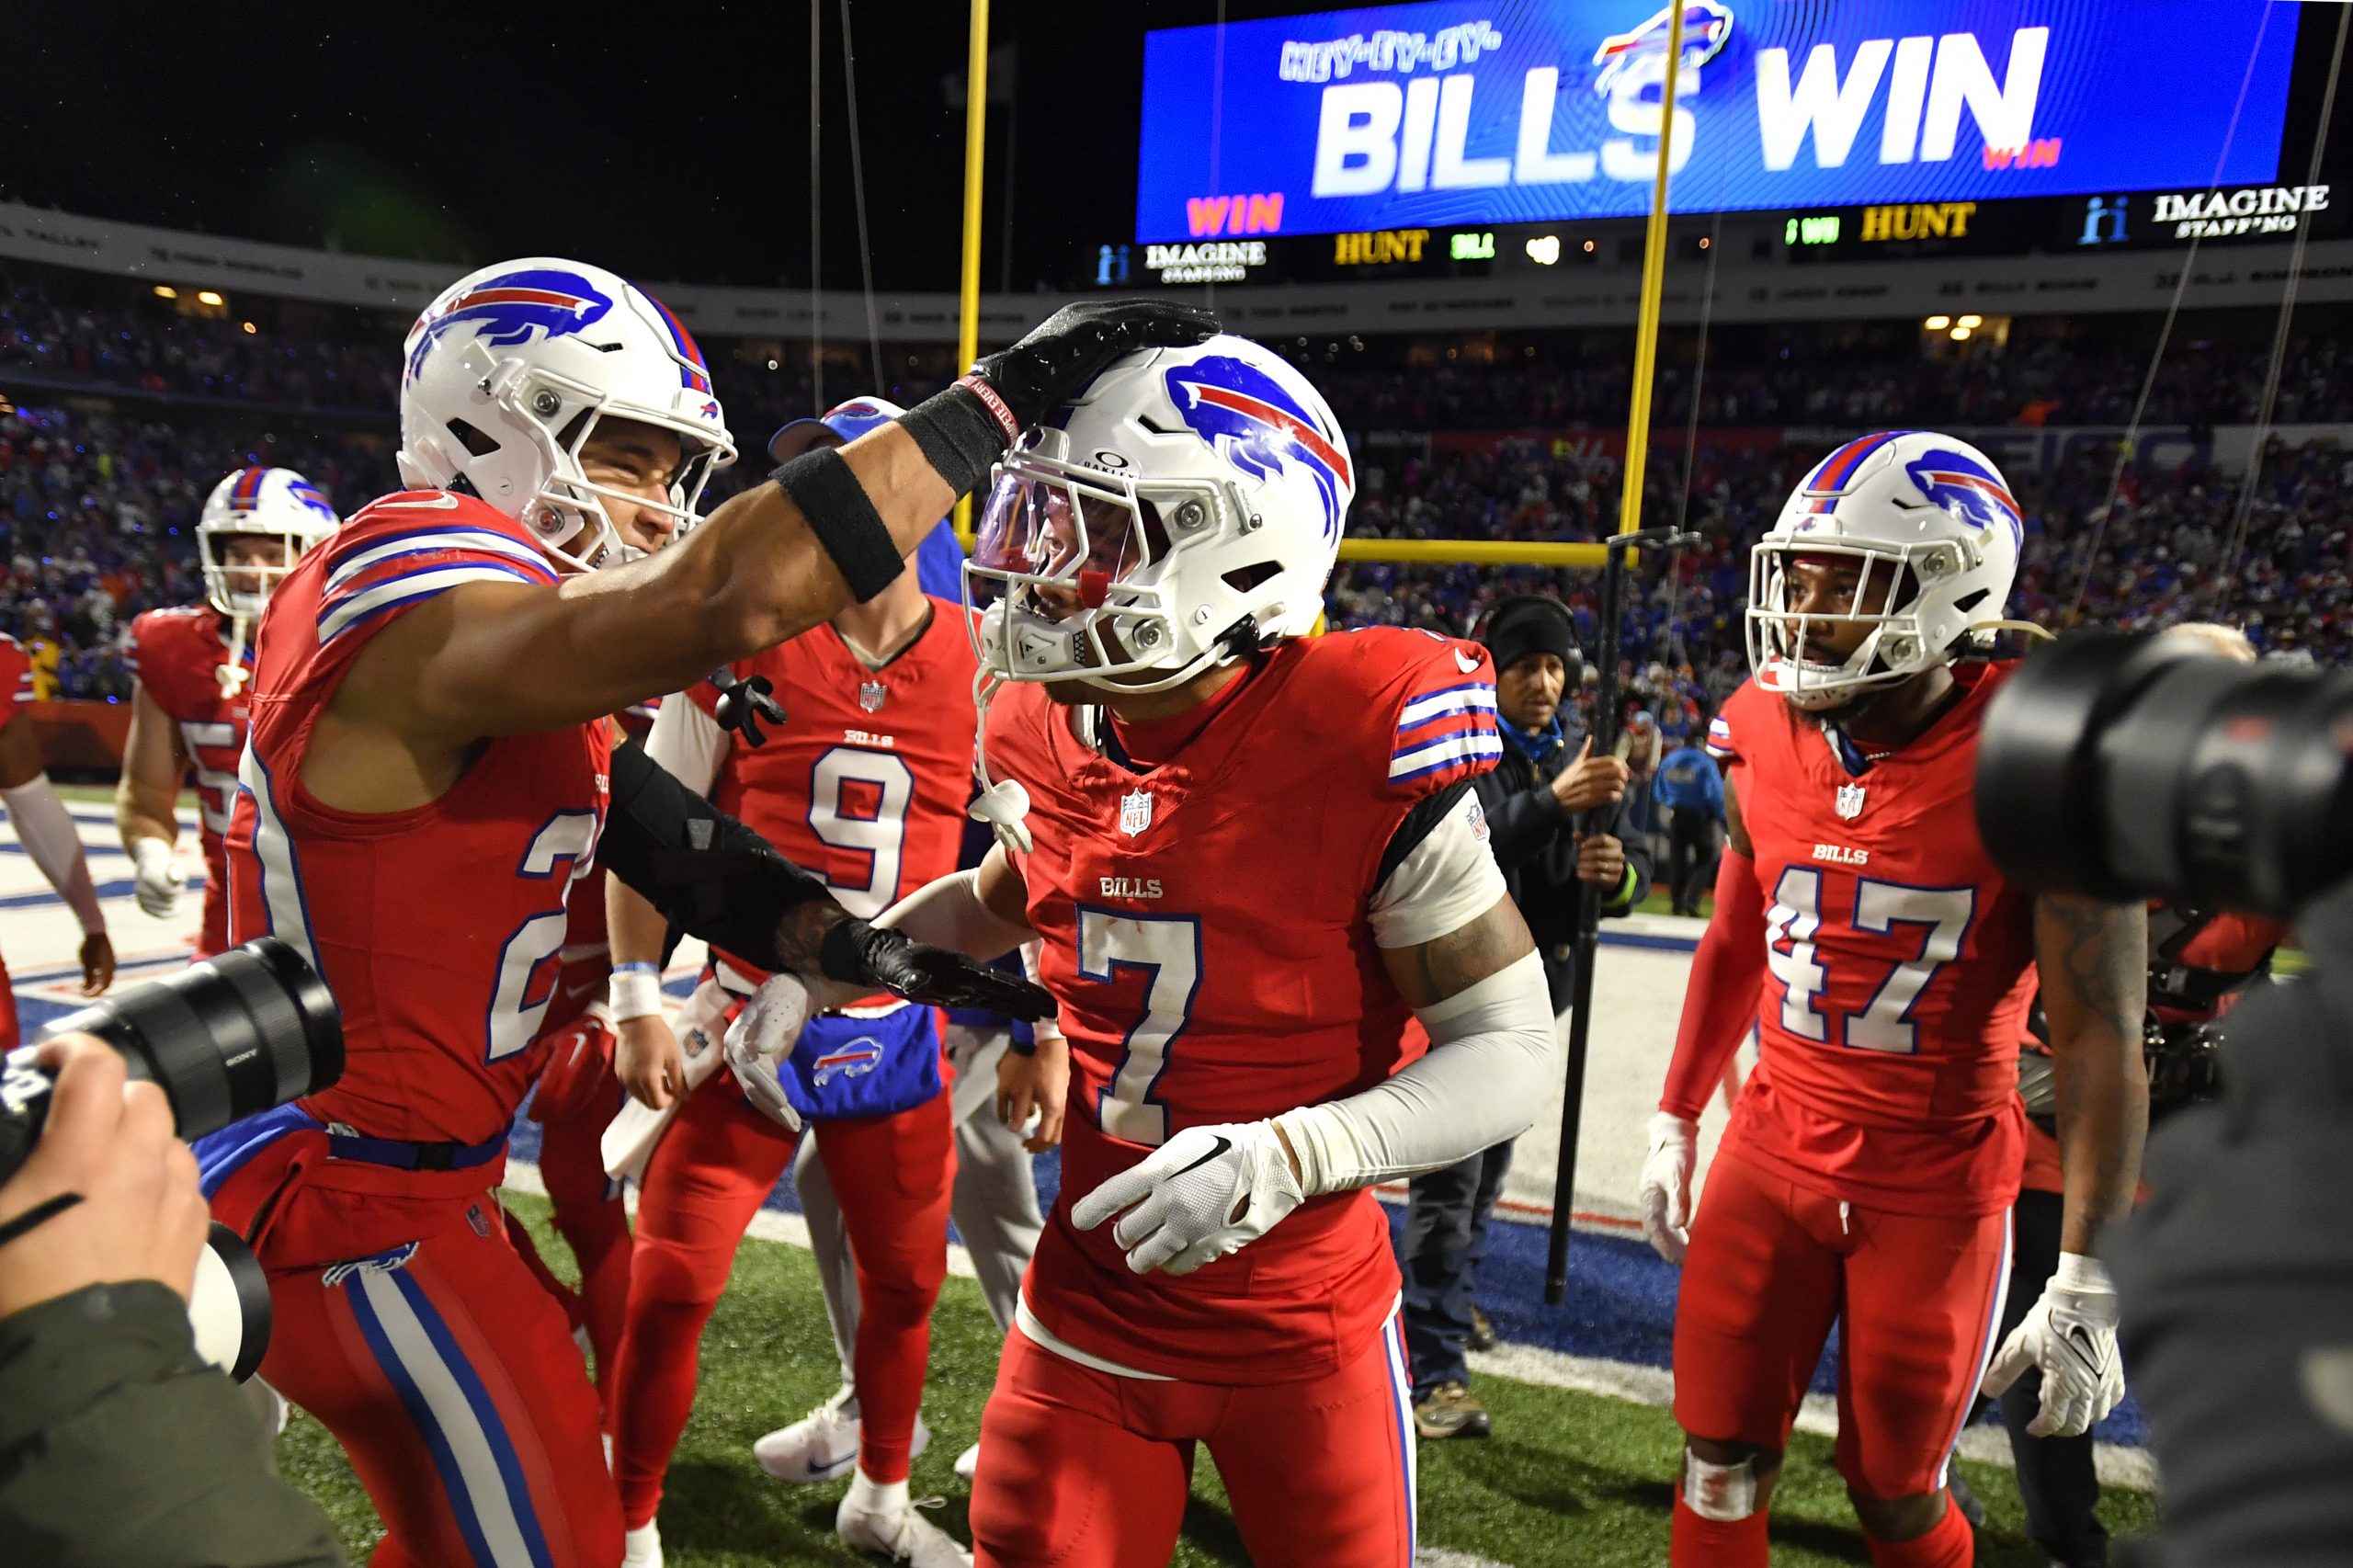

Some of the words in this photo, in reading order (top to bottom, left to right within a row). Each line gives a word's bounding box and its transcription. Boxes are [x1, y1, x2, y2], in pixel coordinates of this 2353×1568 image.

[1312, 65, 1701, 199] BILLS
[1756, 26, 2049, 172] WIN
[1983, 137, 2062, 172] WIN
[1187, 192, 1284, 236] WIN
[1859, 201, 1976, 242] HUNT
[2152, 185, 2330, 222] IMAGINE
[1145, 242, 1267, 268] IMAGINE
[1335, 230, 1429, 265] HUNT
[844, 729, 895, 749] BILLS
[801, 744, 915, 920] 9
[1812, 843, 1870, 866] BILLS
[1099, 876, 1165, 899] BILLS
[1766, 864, 1978, 1055] 47
[1075, 903, 1203, 1147] 7
[226, 1049, 257, 1067] SONY
